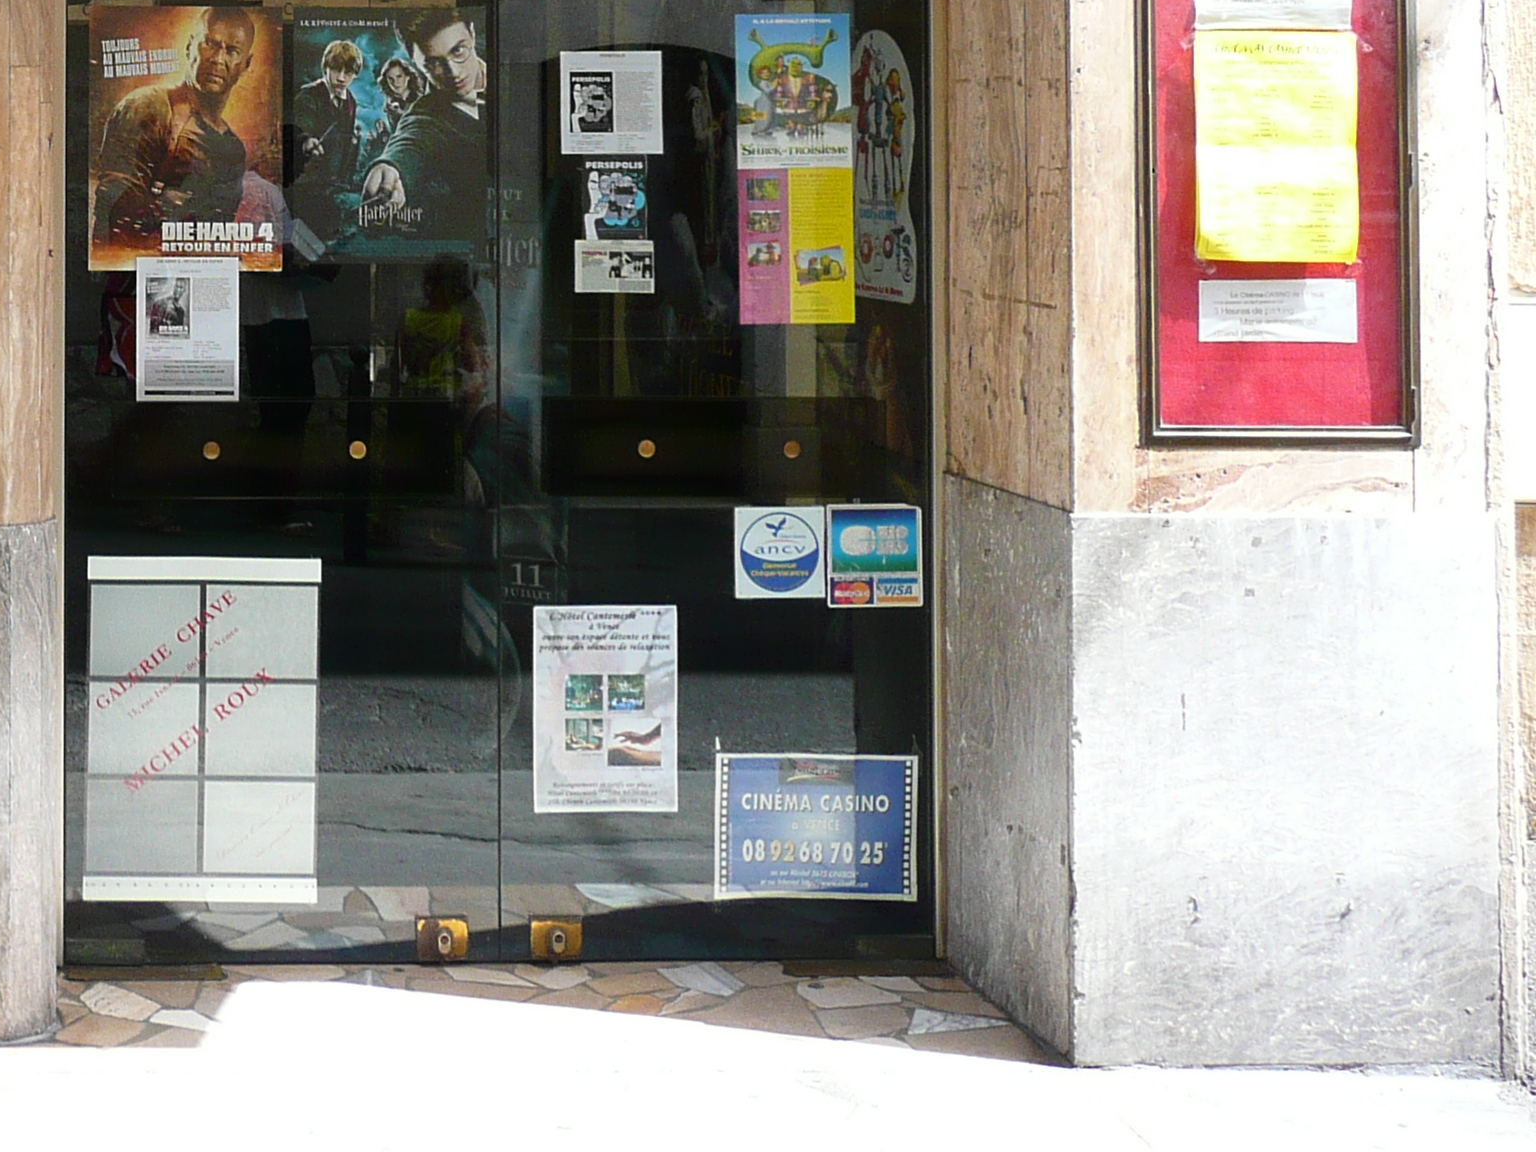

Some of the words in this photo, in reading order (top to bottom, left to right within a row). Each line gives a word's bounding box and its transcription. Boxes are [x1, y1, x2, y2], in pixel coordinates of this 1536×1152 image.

[585, 161, 643, 169] PERSEPOLIS
[162, 222, 194, 241] DIE
[196, 222, 254, 241] HARD
[258, 222, 274, 242] 4
[162, 242, 212, 253] RETOUR
[214, 242, 230, 253] EN
[233, 242, 274, 253] ENFER
[1221, 306, 1250, 315] Heures
[754, 541, 806, 555] ancv
[511, 561, 543, 588] 11
[884, 584, 914, 597] VISA
[95, 643, 173, 711] GALERIE
[176, 589, 239, 645] CHAVE
[123, 722, 210, 795] MICHEL
[212, 666, 277, 722] ROUX
[741, 788, 813, 812] CINÉMA
[820, 794, 890, 813] CASINO
[805, 819, 842, 831] VENCE
[742, 839, 766, 863] 08
[770, 839, 796, 863] 92
[799, 840, 824, 864] 68
[830, 841, 854, 865] 70
